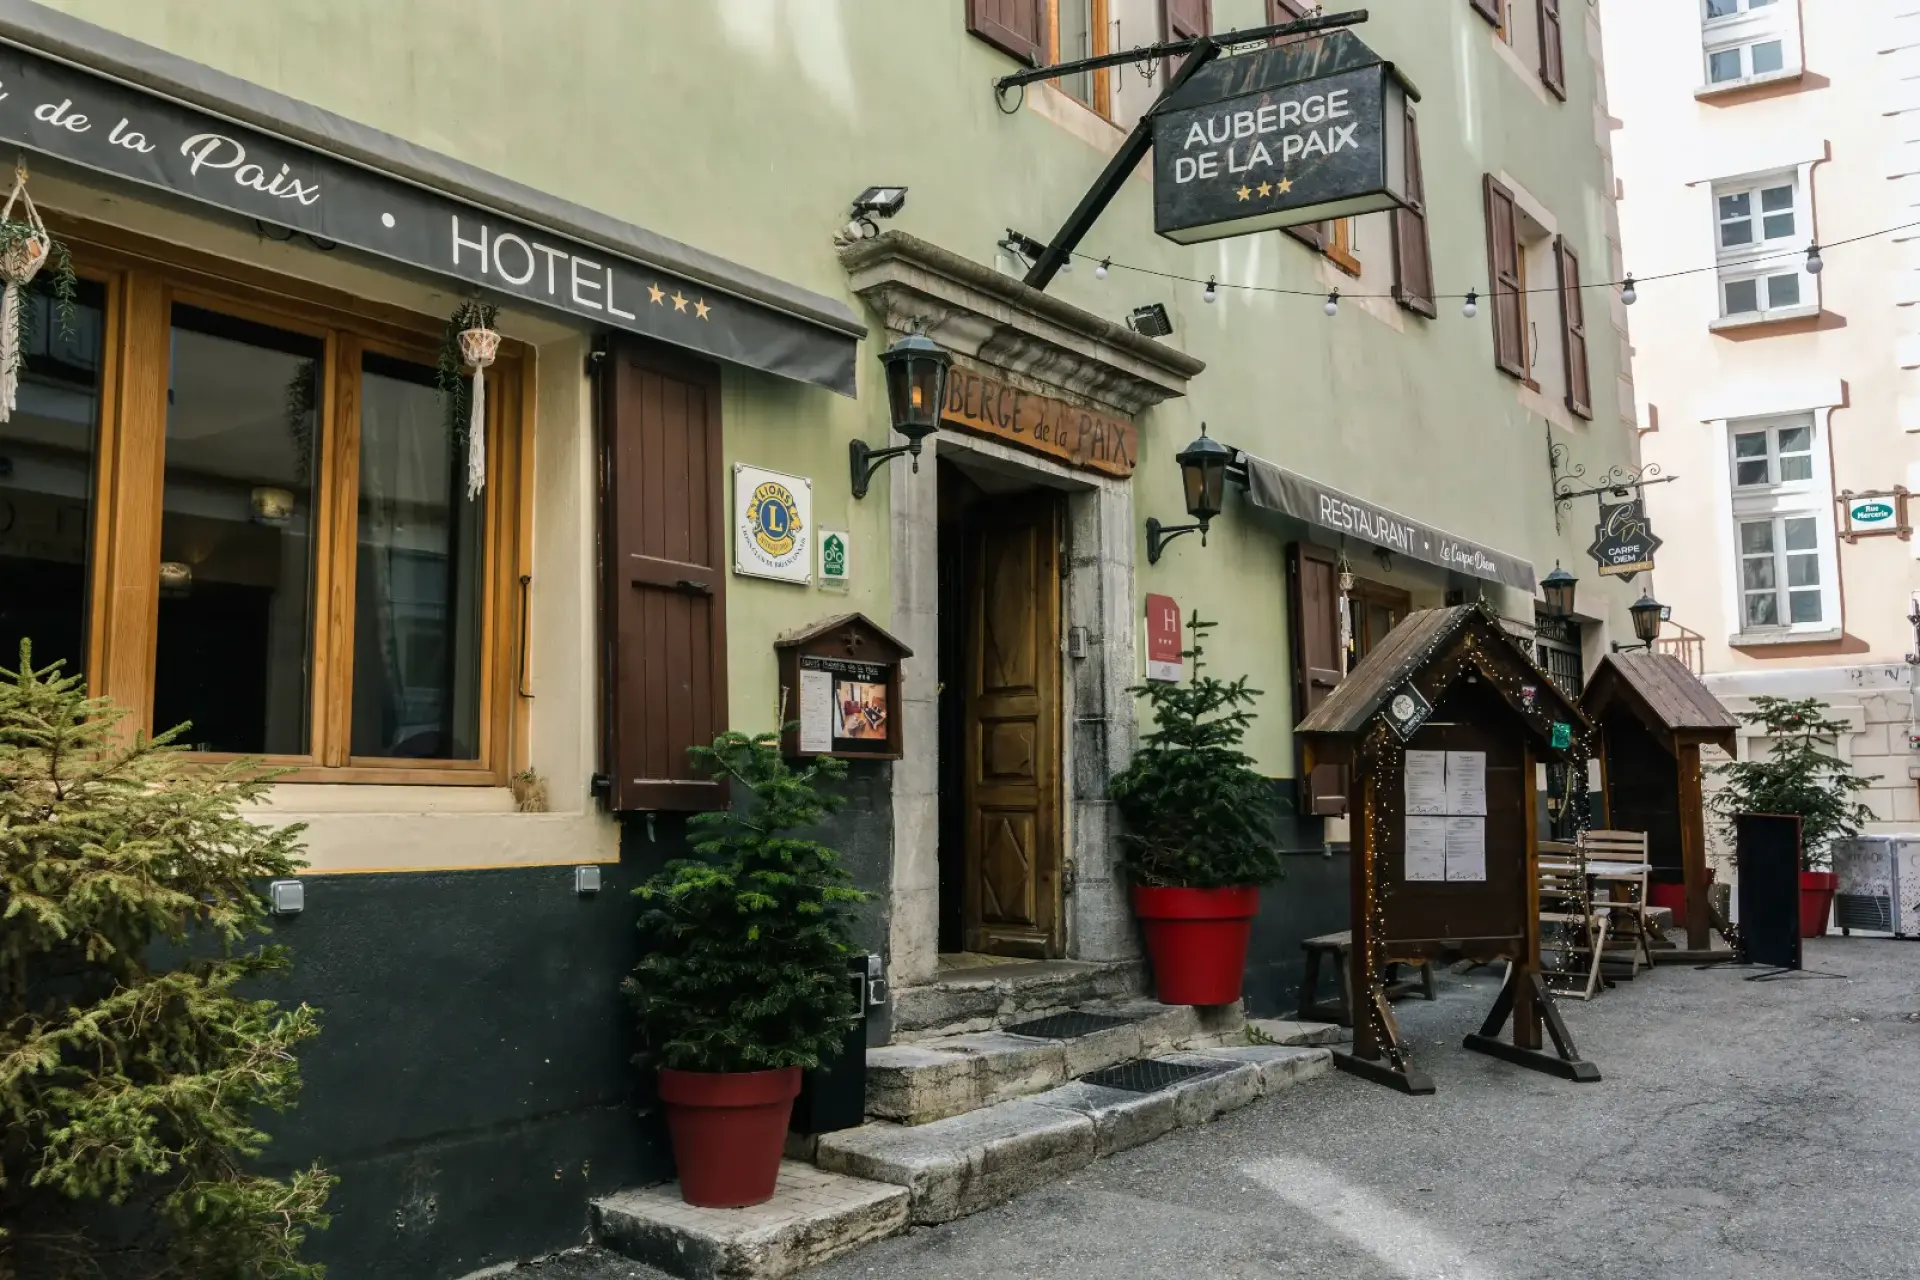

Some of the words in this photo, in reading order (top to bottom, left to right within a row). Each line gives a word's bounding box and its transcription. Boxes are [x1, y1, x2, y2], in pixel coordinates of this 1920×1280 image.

[1183, 88, 1349, 150] AUBERGE
[1175, 151, 1218, 184] DE
[1228, 141, 1274, 174] LA
[1282, 121, 1359, 162] PAIX
[34, 98, 91, 133] de
[108, 117, 155, 153] la
[180, 133, 320, 206] Paix
[452, 215, 636, 320] HOTEL
[1033, 413, 1050, 442] de
[1053, 417, 1068, 447] la
[1077, 414, 1130, 466] PAIX
[758, 485, 791, 505] LIONS
[769, 505, 783, 532] L
[1857, 510, 1889, 519] Mercerie
[1865, 505, 1879, 513] Rue
[1320, 493, 1415, 551] RESTAURANT
[1440, 540, 1450, 561] Le
[1451, 542, 1475, 568] Carpe
[1474, 550, 1496, 573] Diem
[1608, 544, 1641, 556] CARPE
[1613, 554, 1636, 564] DIEM
[1164, 608, 1176, 633] H
